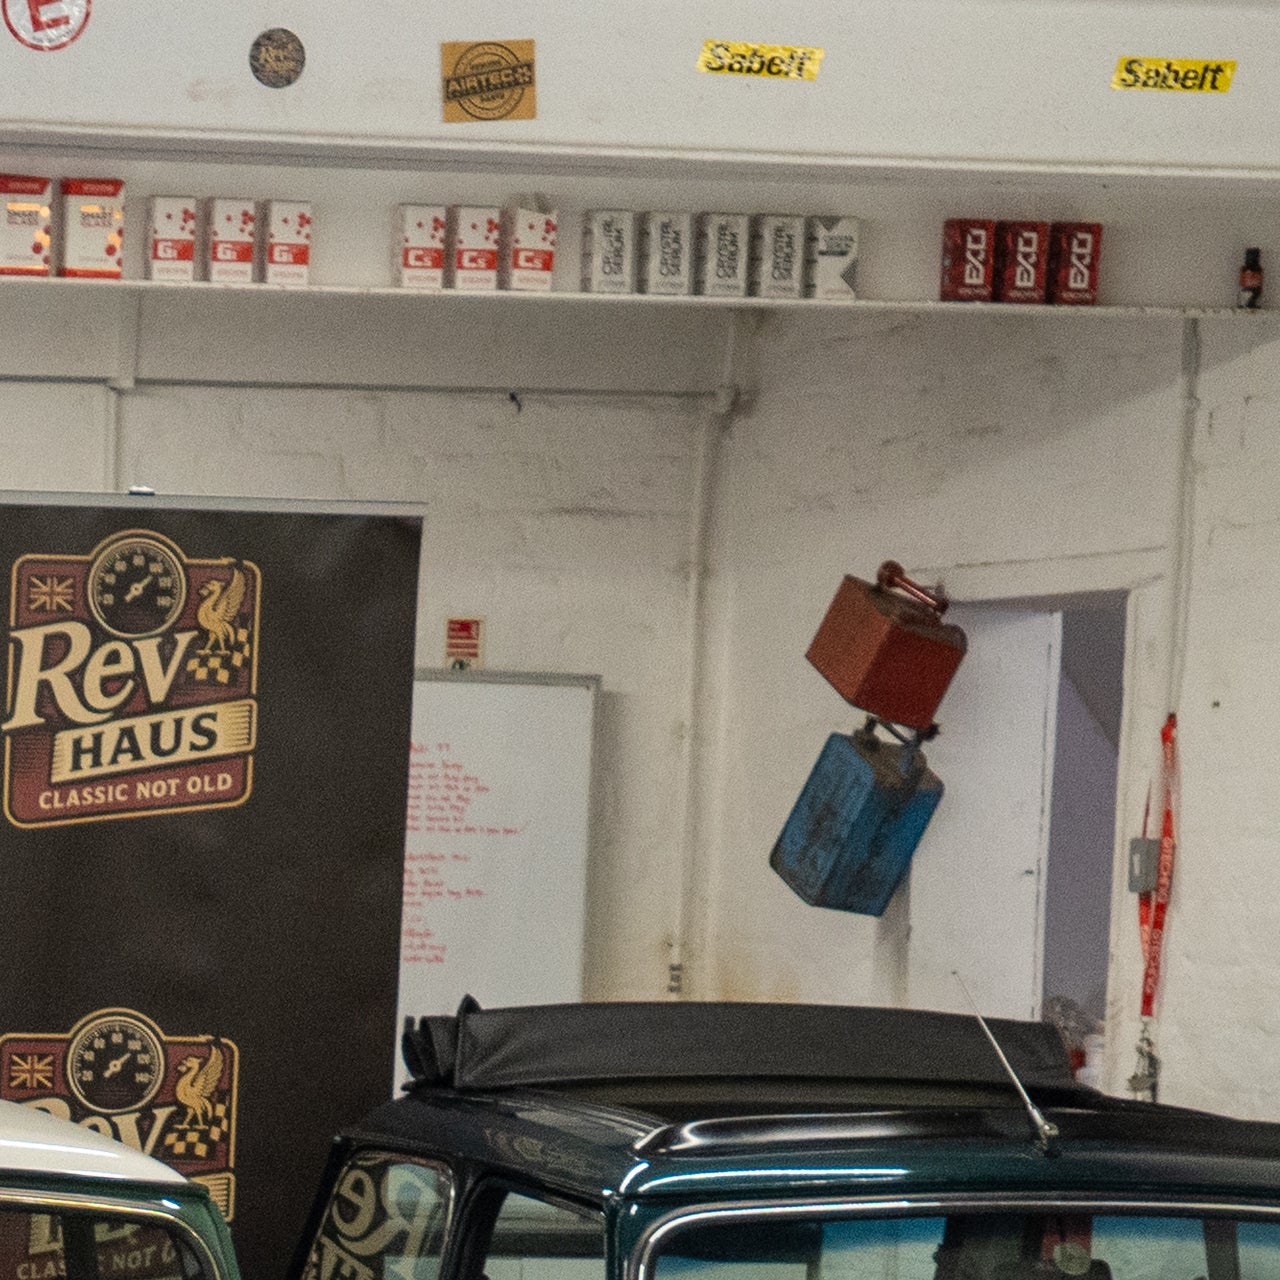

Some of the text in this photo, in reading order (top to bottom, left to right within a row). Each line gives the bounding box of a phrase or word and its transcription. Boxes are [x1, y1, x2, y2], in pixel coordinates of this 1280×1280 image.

[1, 620, 198, 730] Rev
[70, 712, 218, 773] HAUS
[39, 772, 233, 810] CLASSIC NOT OLD
